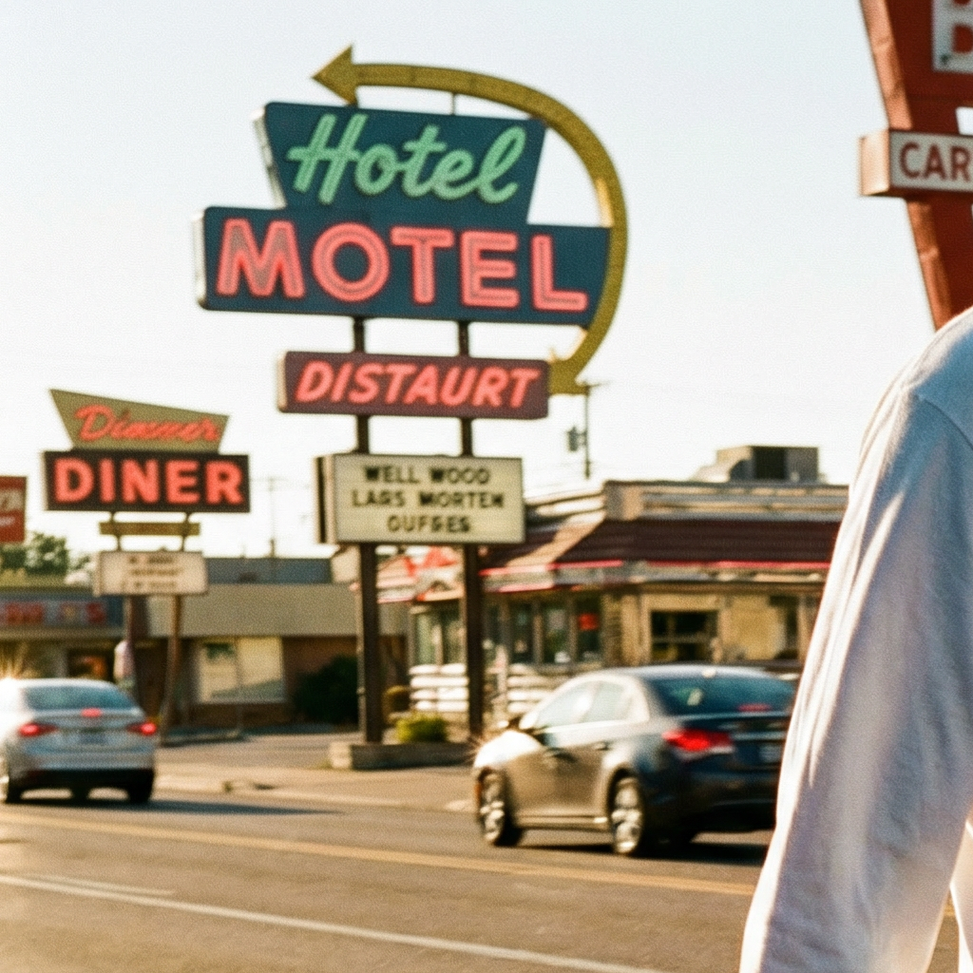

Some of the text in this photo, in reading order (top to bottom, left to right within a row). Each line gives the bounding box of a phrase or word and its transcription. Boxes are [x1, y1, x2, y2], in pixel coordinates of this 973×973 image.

[287, 112, 528, 206] Hotel
[215, 218, 588, 312] MOTEL
[294, 360, 541, 410] DISTAURT
[54, 457, 244, 505] DINER
[364, 465, 420, 484] WELL
